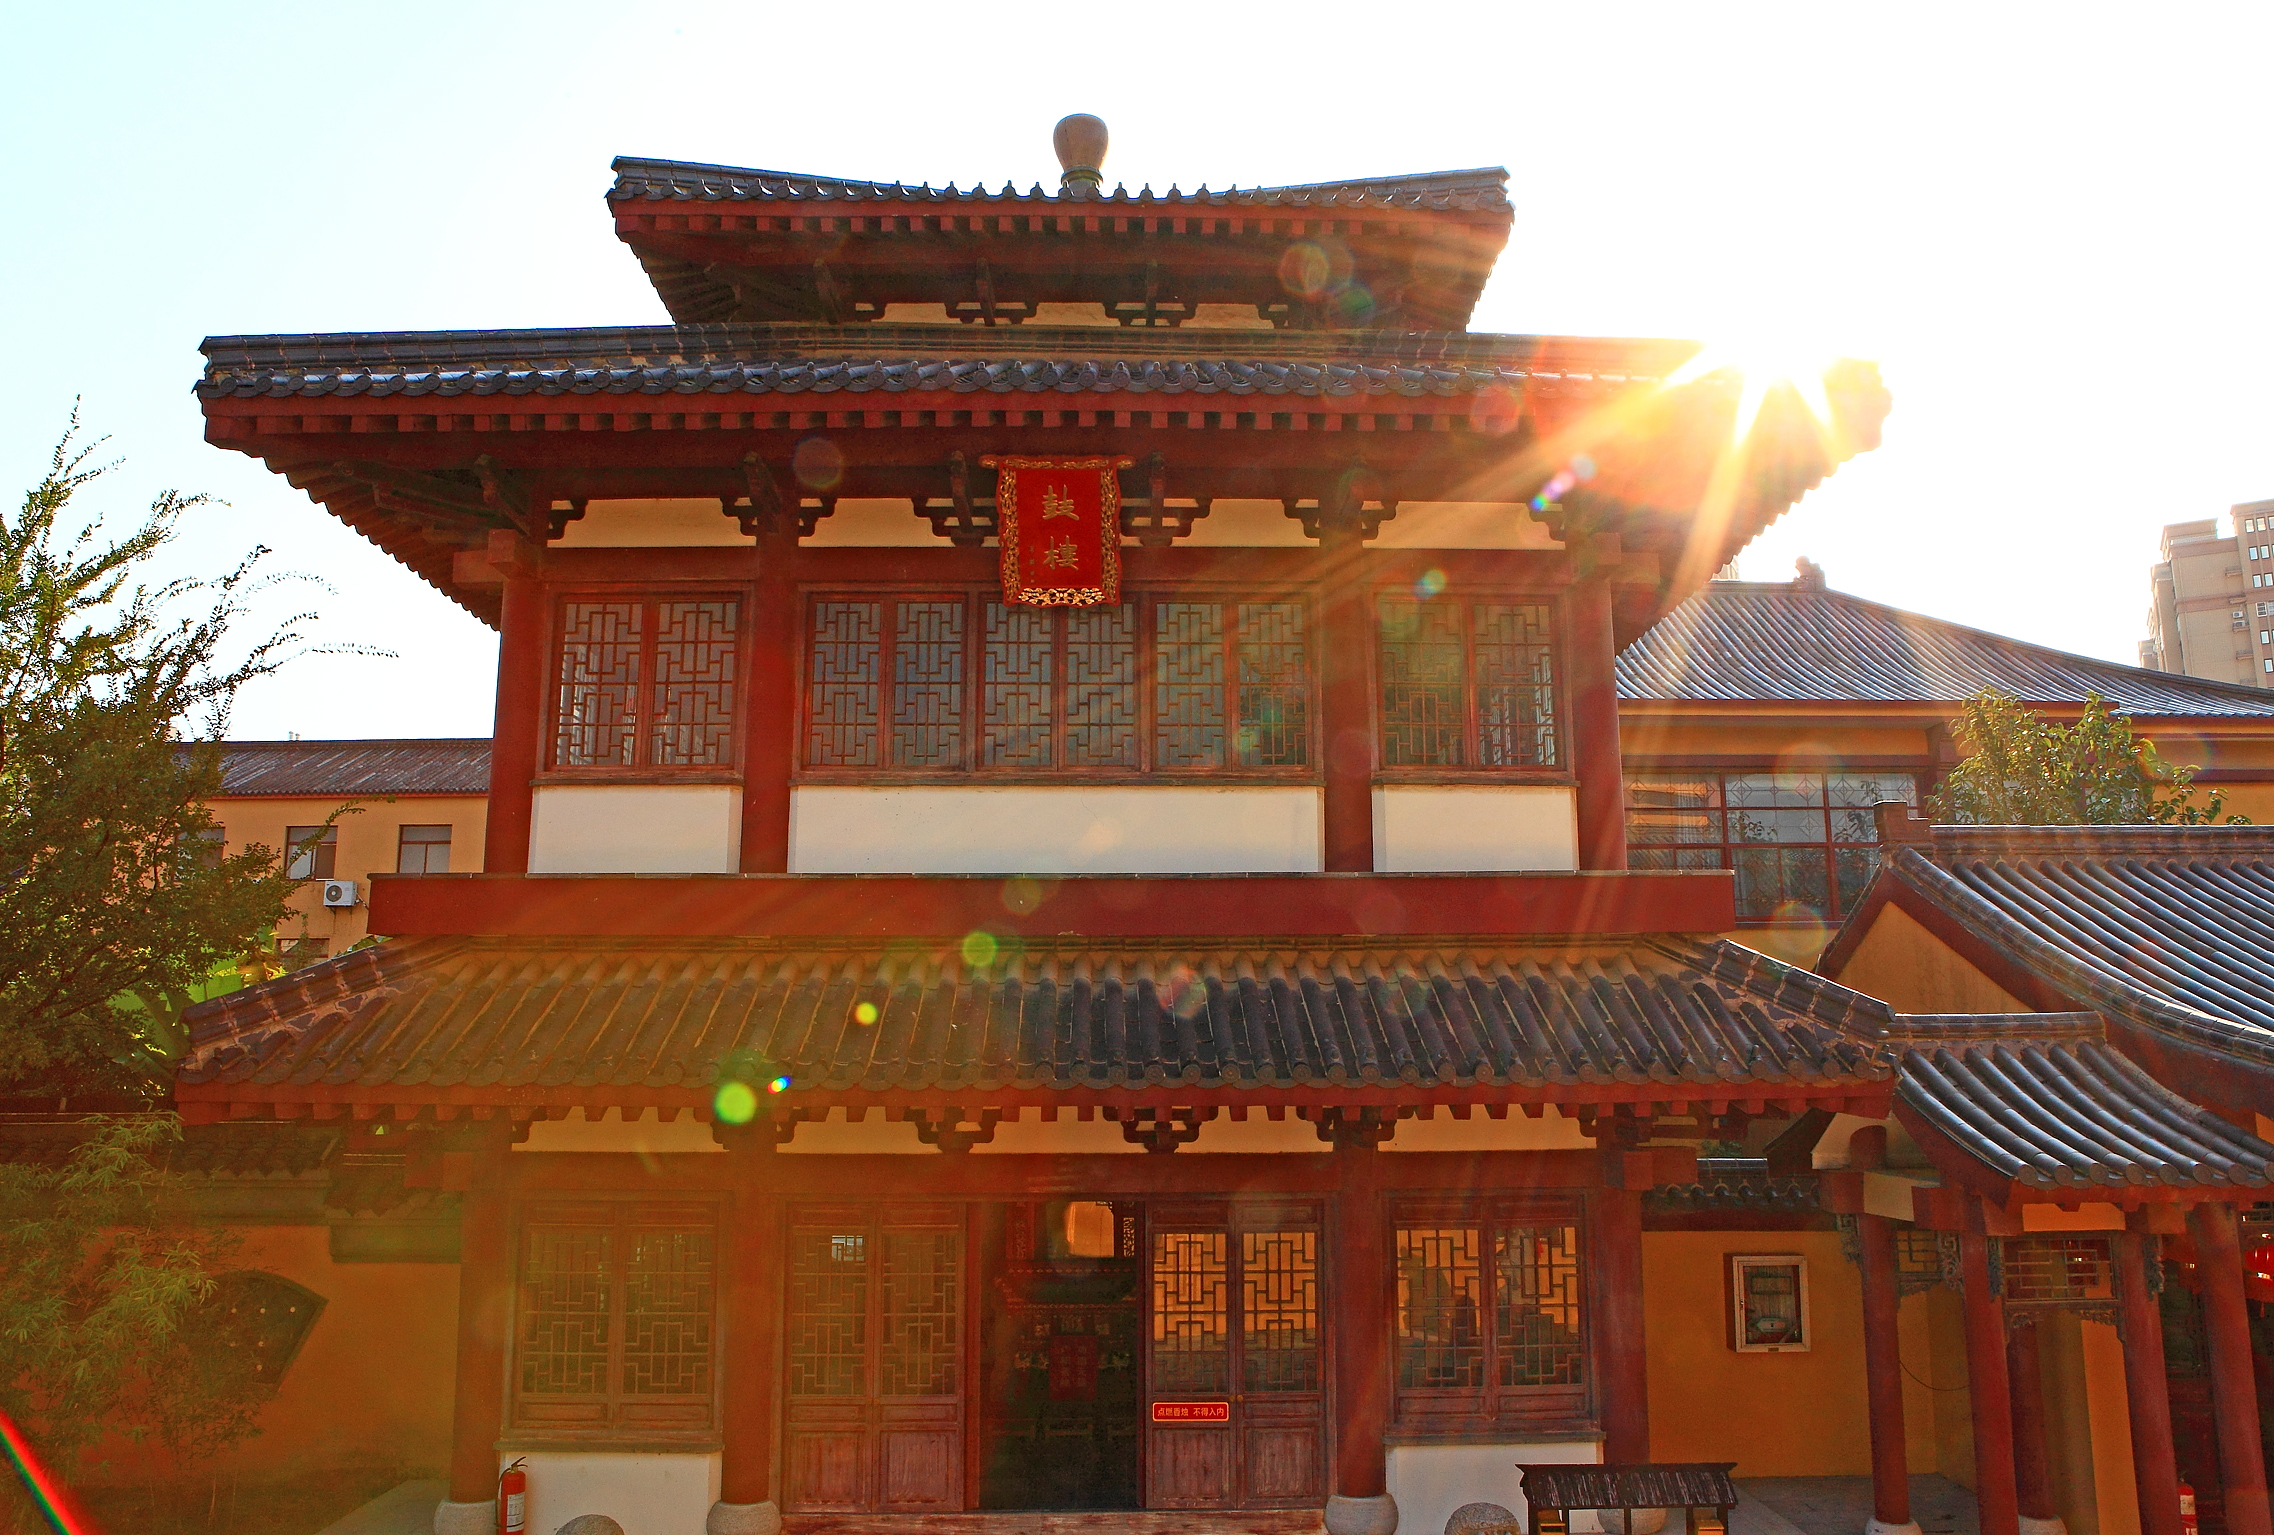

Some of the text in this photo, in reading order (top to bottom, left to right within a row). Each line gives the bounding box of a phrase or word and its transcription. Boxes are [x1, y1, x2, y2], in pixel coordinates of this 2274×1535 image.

[1042, 484, 1079, 570] 鼓樓
[1157, 1407, 1225, 1417] 点燃香烛 不得入内
